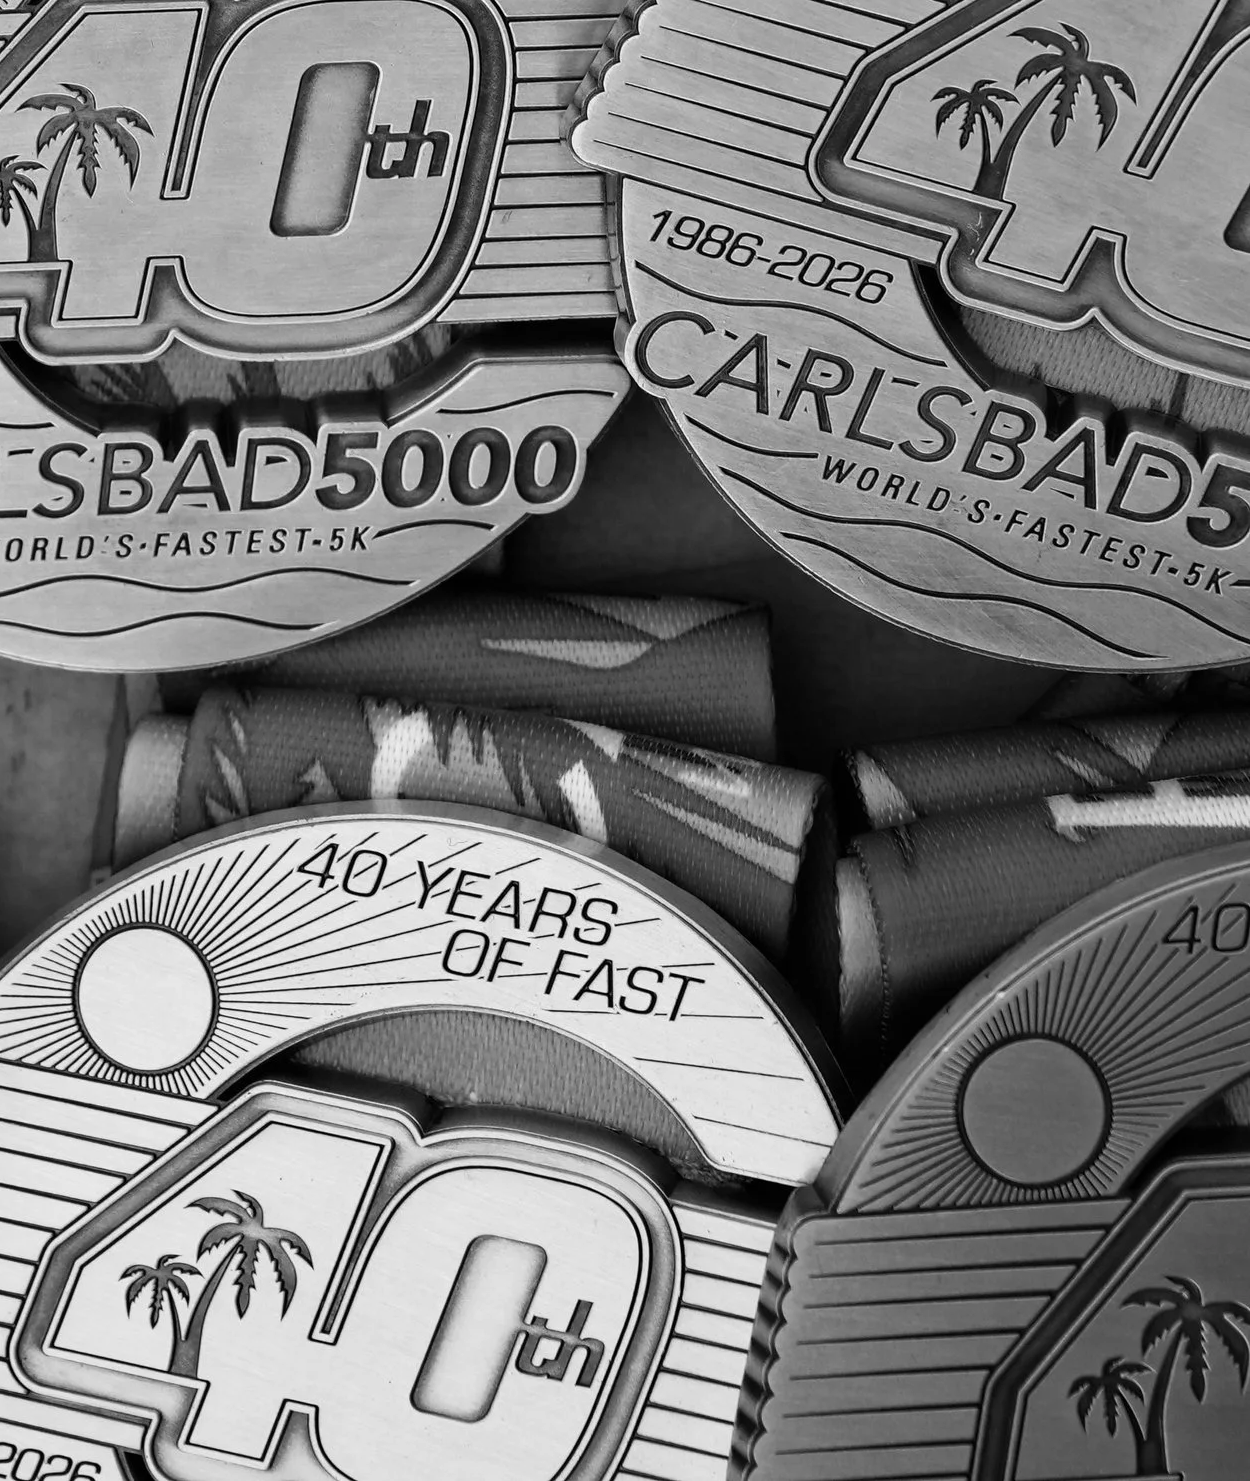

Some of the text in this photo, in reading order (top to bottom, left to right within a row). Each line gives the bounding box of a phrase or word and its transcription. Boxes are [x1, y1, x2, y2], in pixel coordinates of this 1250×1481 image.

[650, 209, 893, 304] 1986-2026
[298, 842, 620, 945] 40 YEARS
[1162, 905, 1250, 954] 40
[441, 930, 704, 1022] OF FAST
